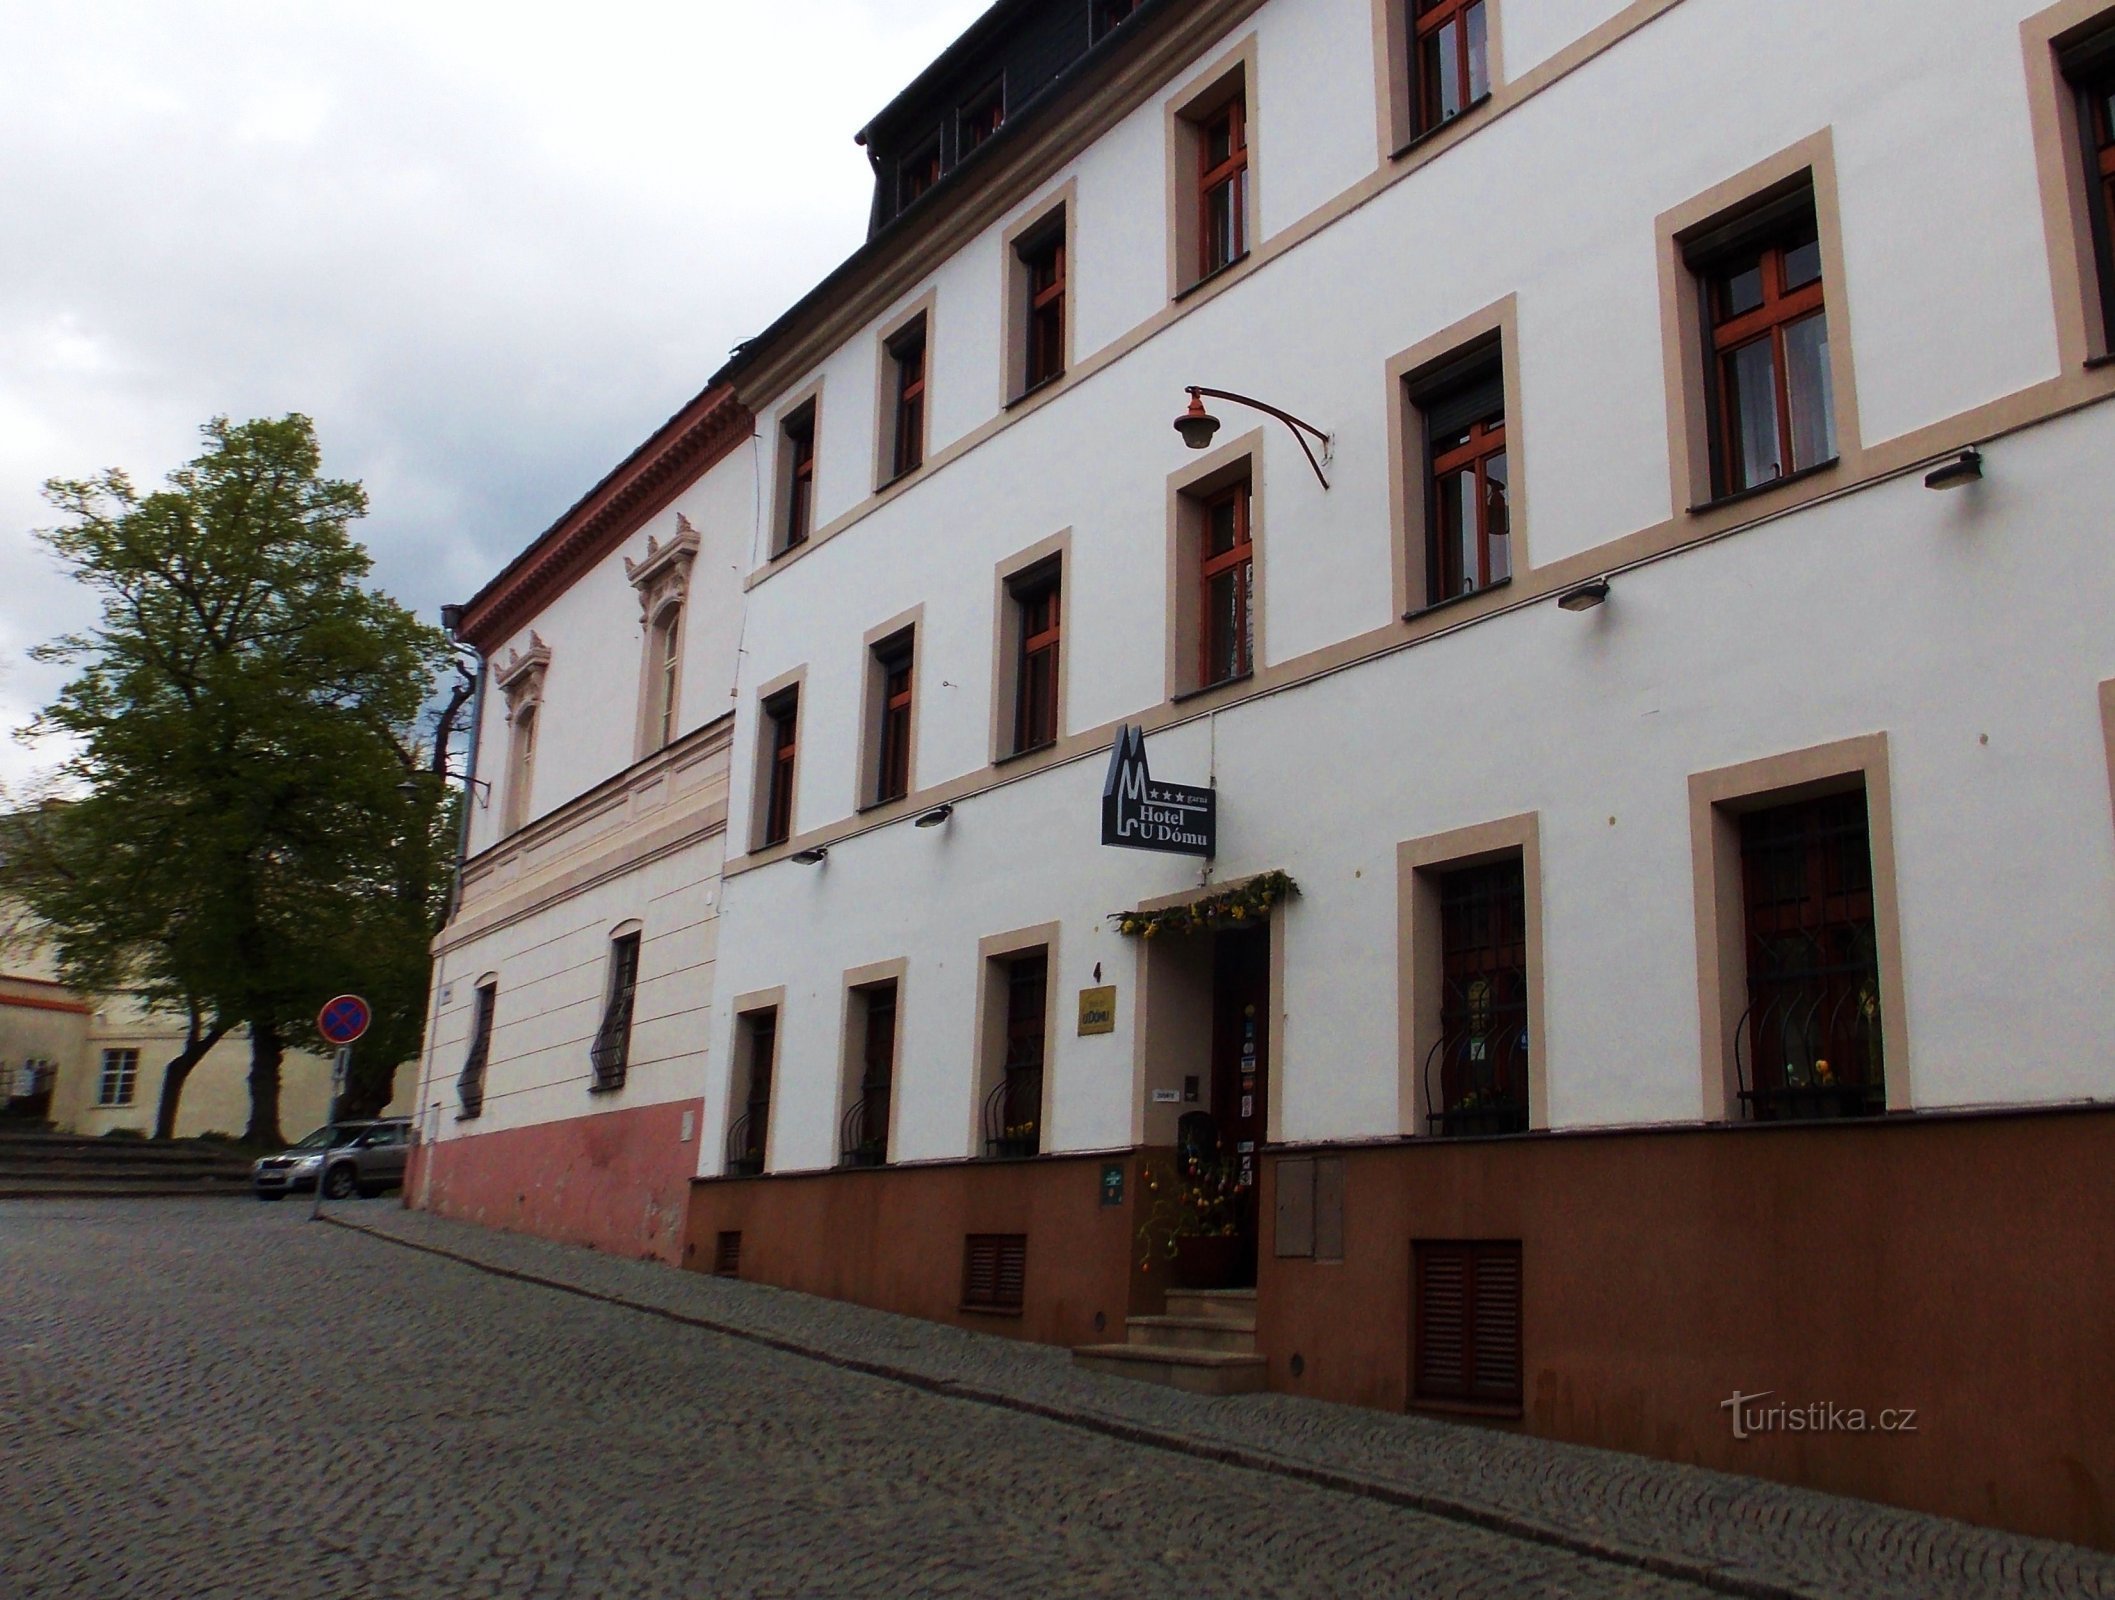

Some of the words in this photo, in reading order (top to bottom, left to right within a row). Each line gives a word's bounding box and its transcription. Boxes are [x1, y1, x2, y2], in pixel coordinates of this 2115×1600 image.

[1140, 805, 1184, 826] Hotel
[1140, 824, 1153, 839] U
[1157, 826, 1207, 845] Dómu
